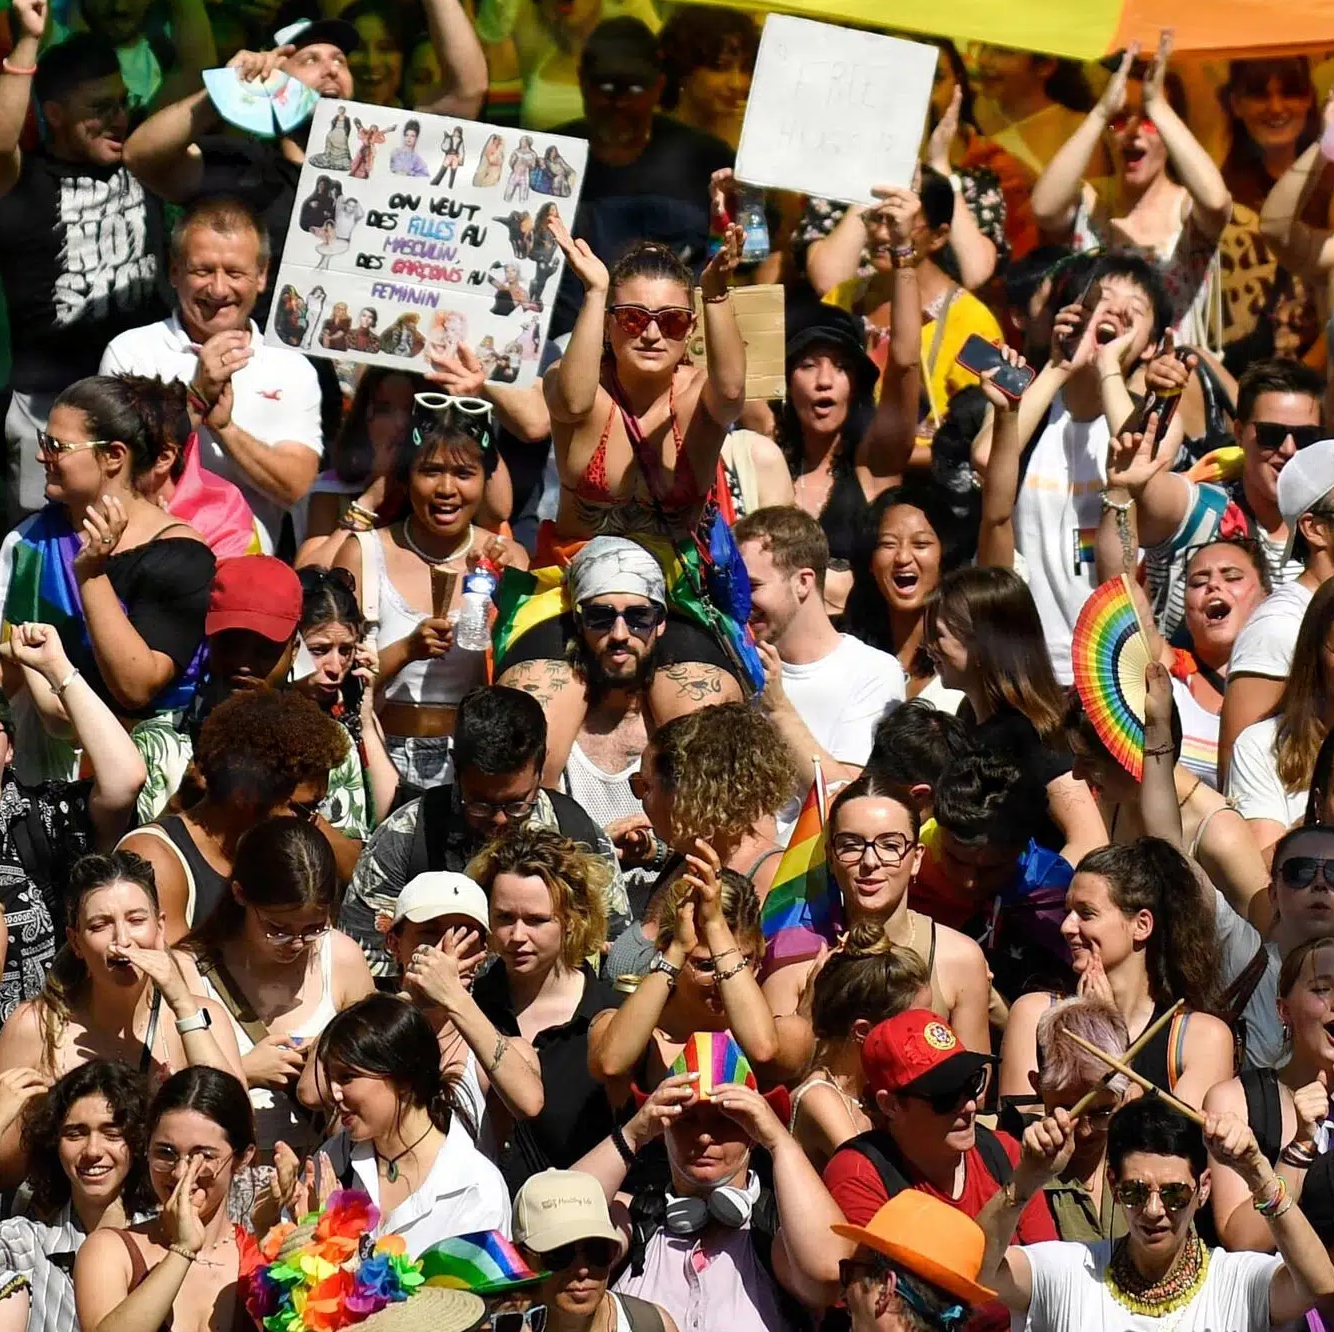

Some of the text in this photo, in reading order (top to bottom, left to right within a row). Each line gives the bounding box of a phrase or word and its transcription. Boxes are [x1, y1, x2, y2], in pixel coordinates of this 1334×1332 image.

[388, 192, 482, 222] ON VEUT
[365, 208, 399, 231] DES
[460, 223, 488, 248] AU
[355, 252, 386, 270] DES
[467, 270, 487, 286] AU
